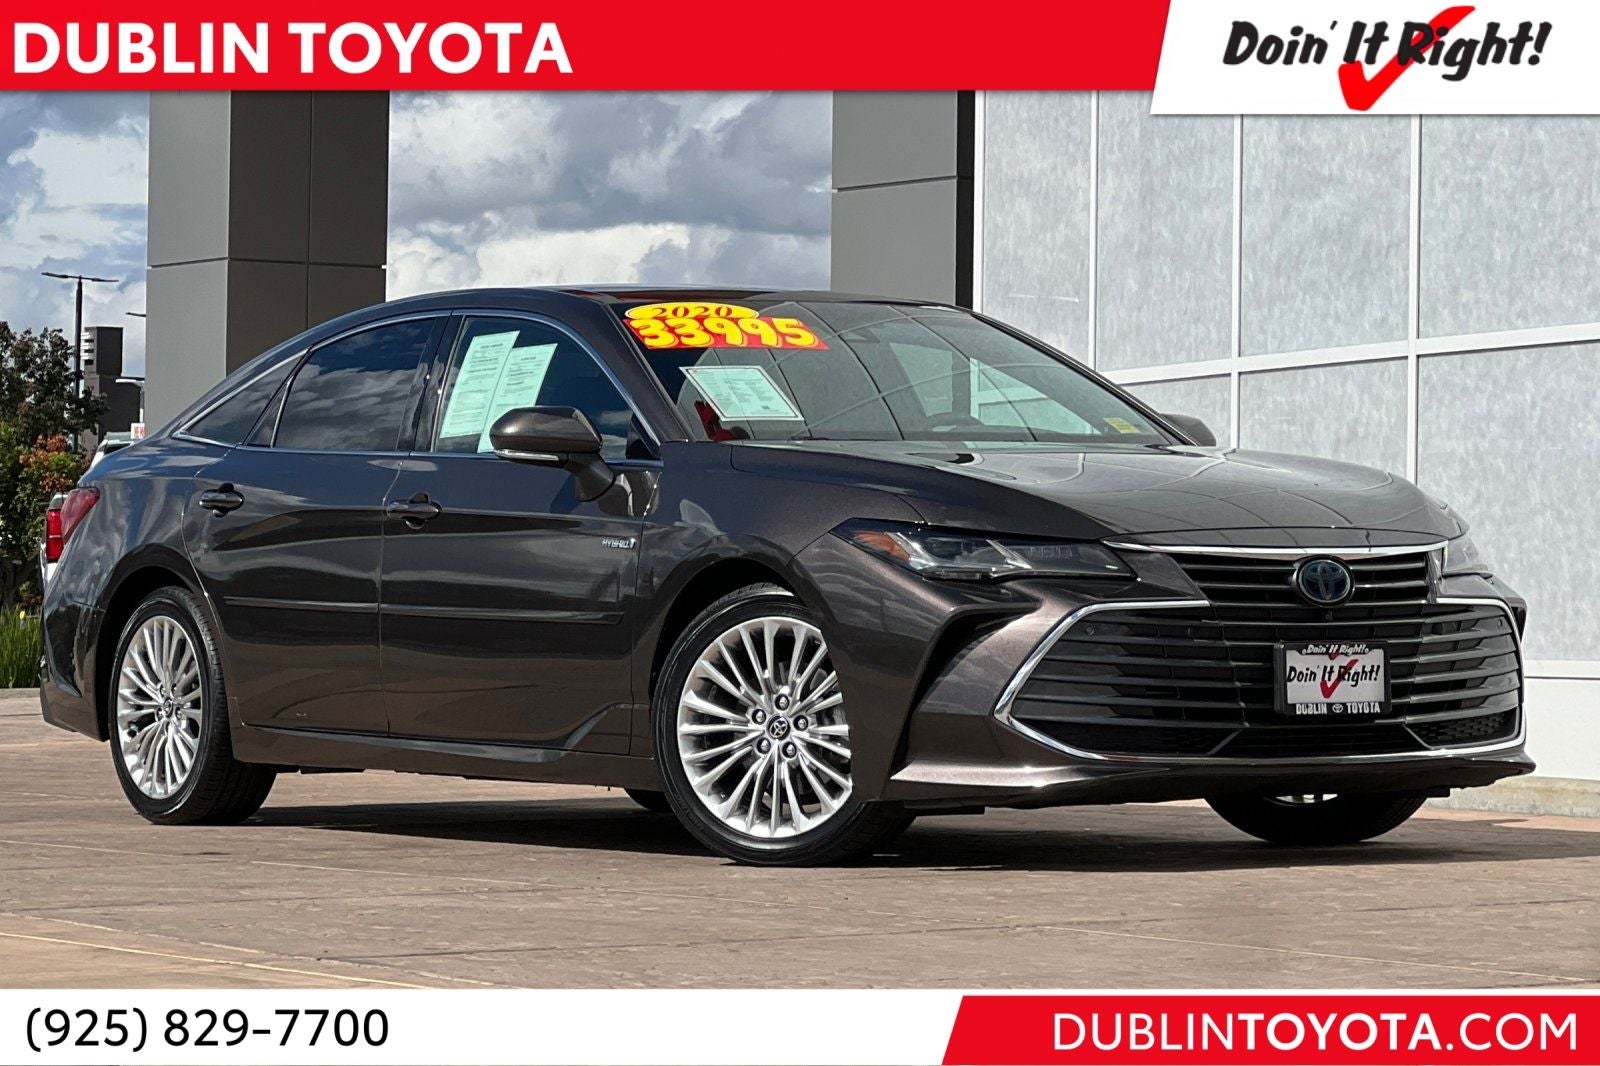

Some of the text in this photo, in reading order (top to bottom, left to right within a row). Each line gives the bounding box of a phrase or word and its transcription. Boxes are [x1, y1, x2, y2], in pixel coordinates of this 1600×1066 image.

[651, 305, 733, 318] 2020
[629, 318, 820, 347] 33995
[1287, 664, 1381, 687] Doin' It Right!
[1296, 702, 1381, 715] DUBLIN TOYOTA
